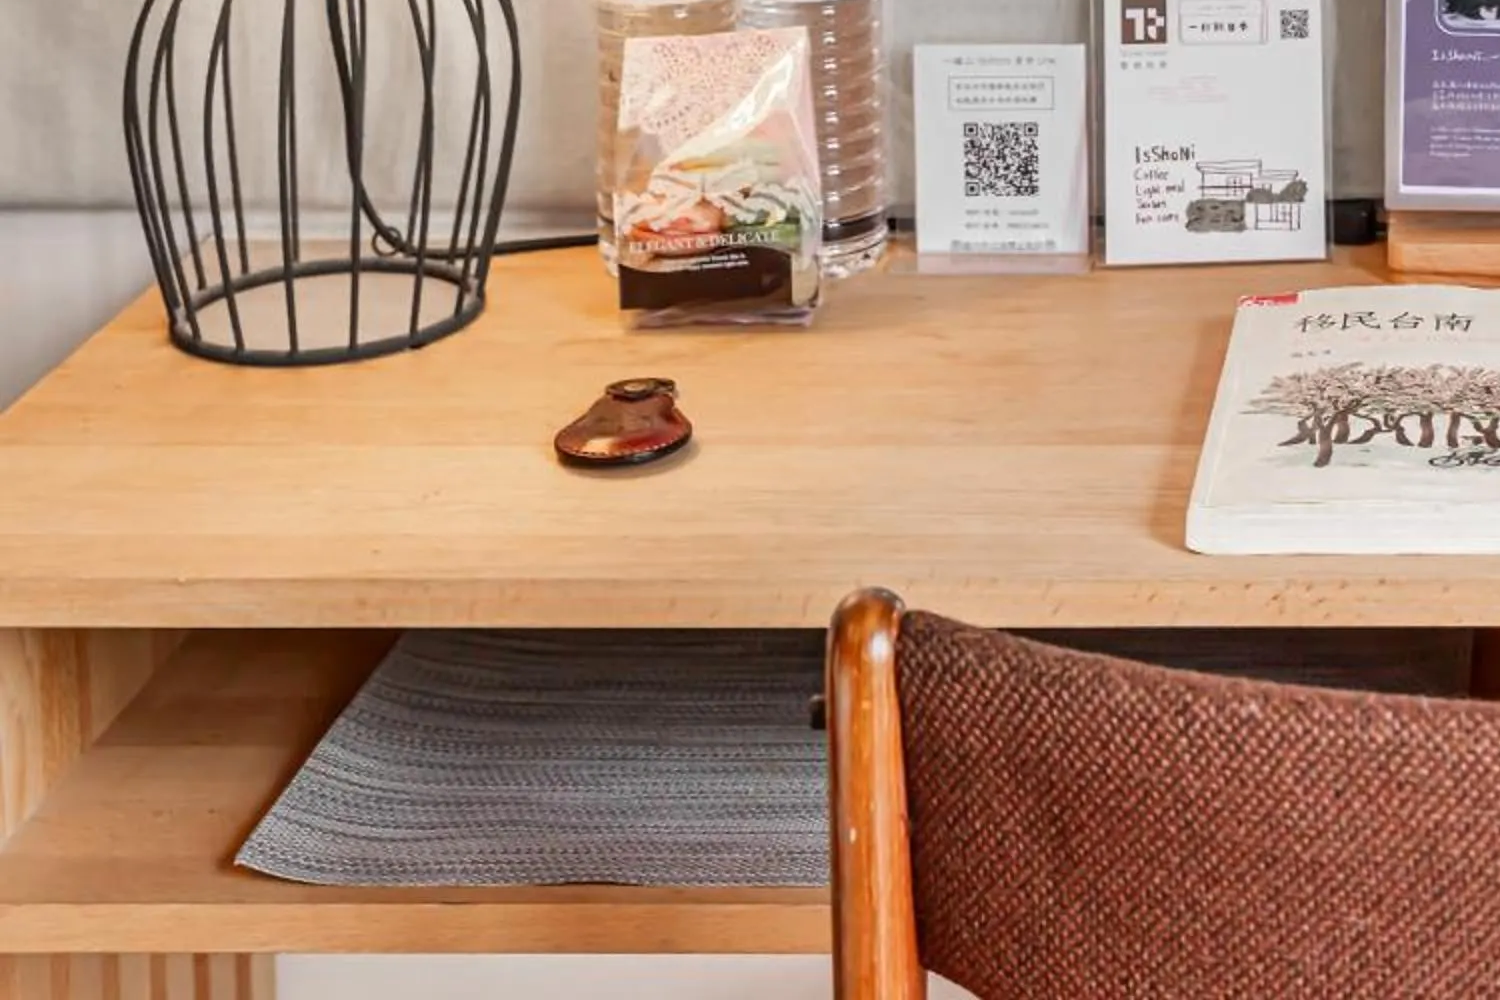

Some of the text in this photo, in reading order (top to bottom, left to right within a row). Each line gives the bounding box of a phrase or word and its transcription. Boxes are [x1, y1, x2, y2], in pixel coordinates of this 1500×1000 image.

[629, 237, 692, 252] ELEGANT
[709, 230, 780, 247] DELICATE
[1295, 311, 1475, 333] 移民台南
